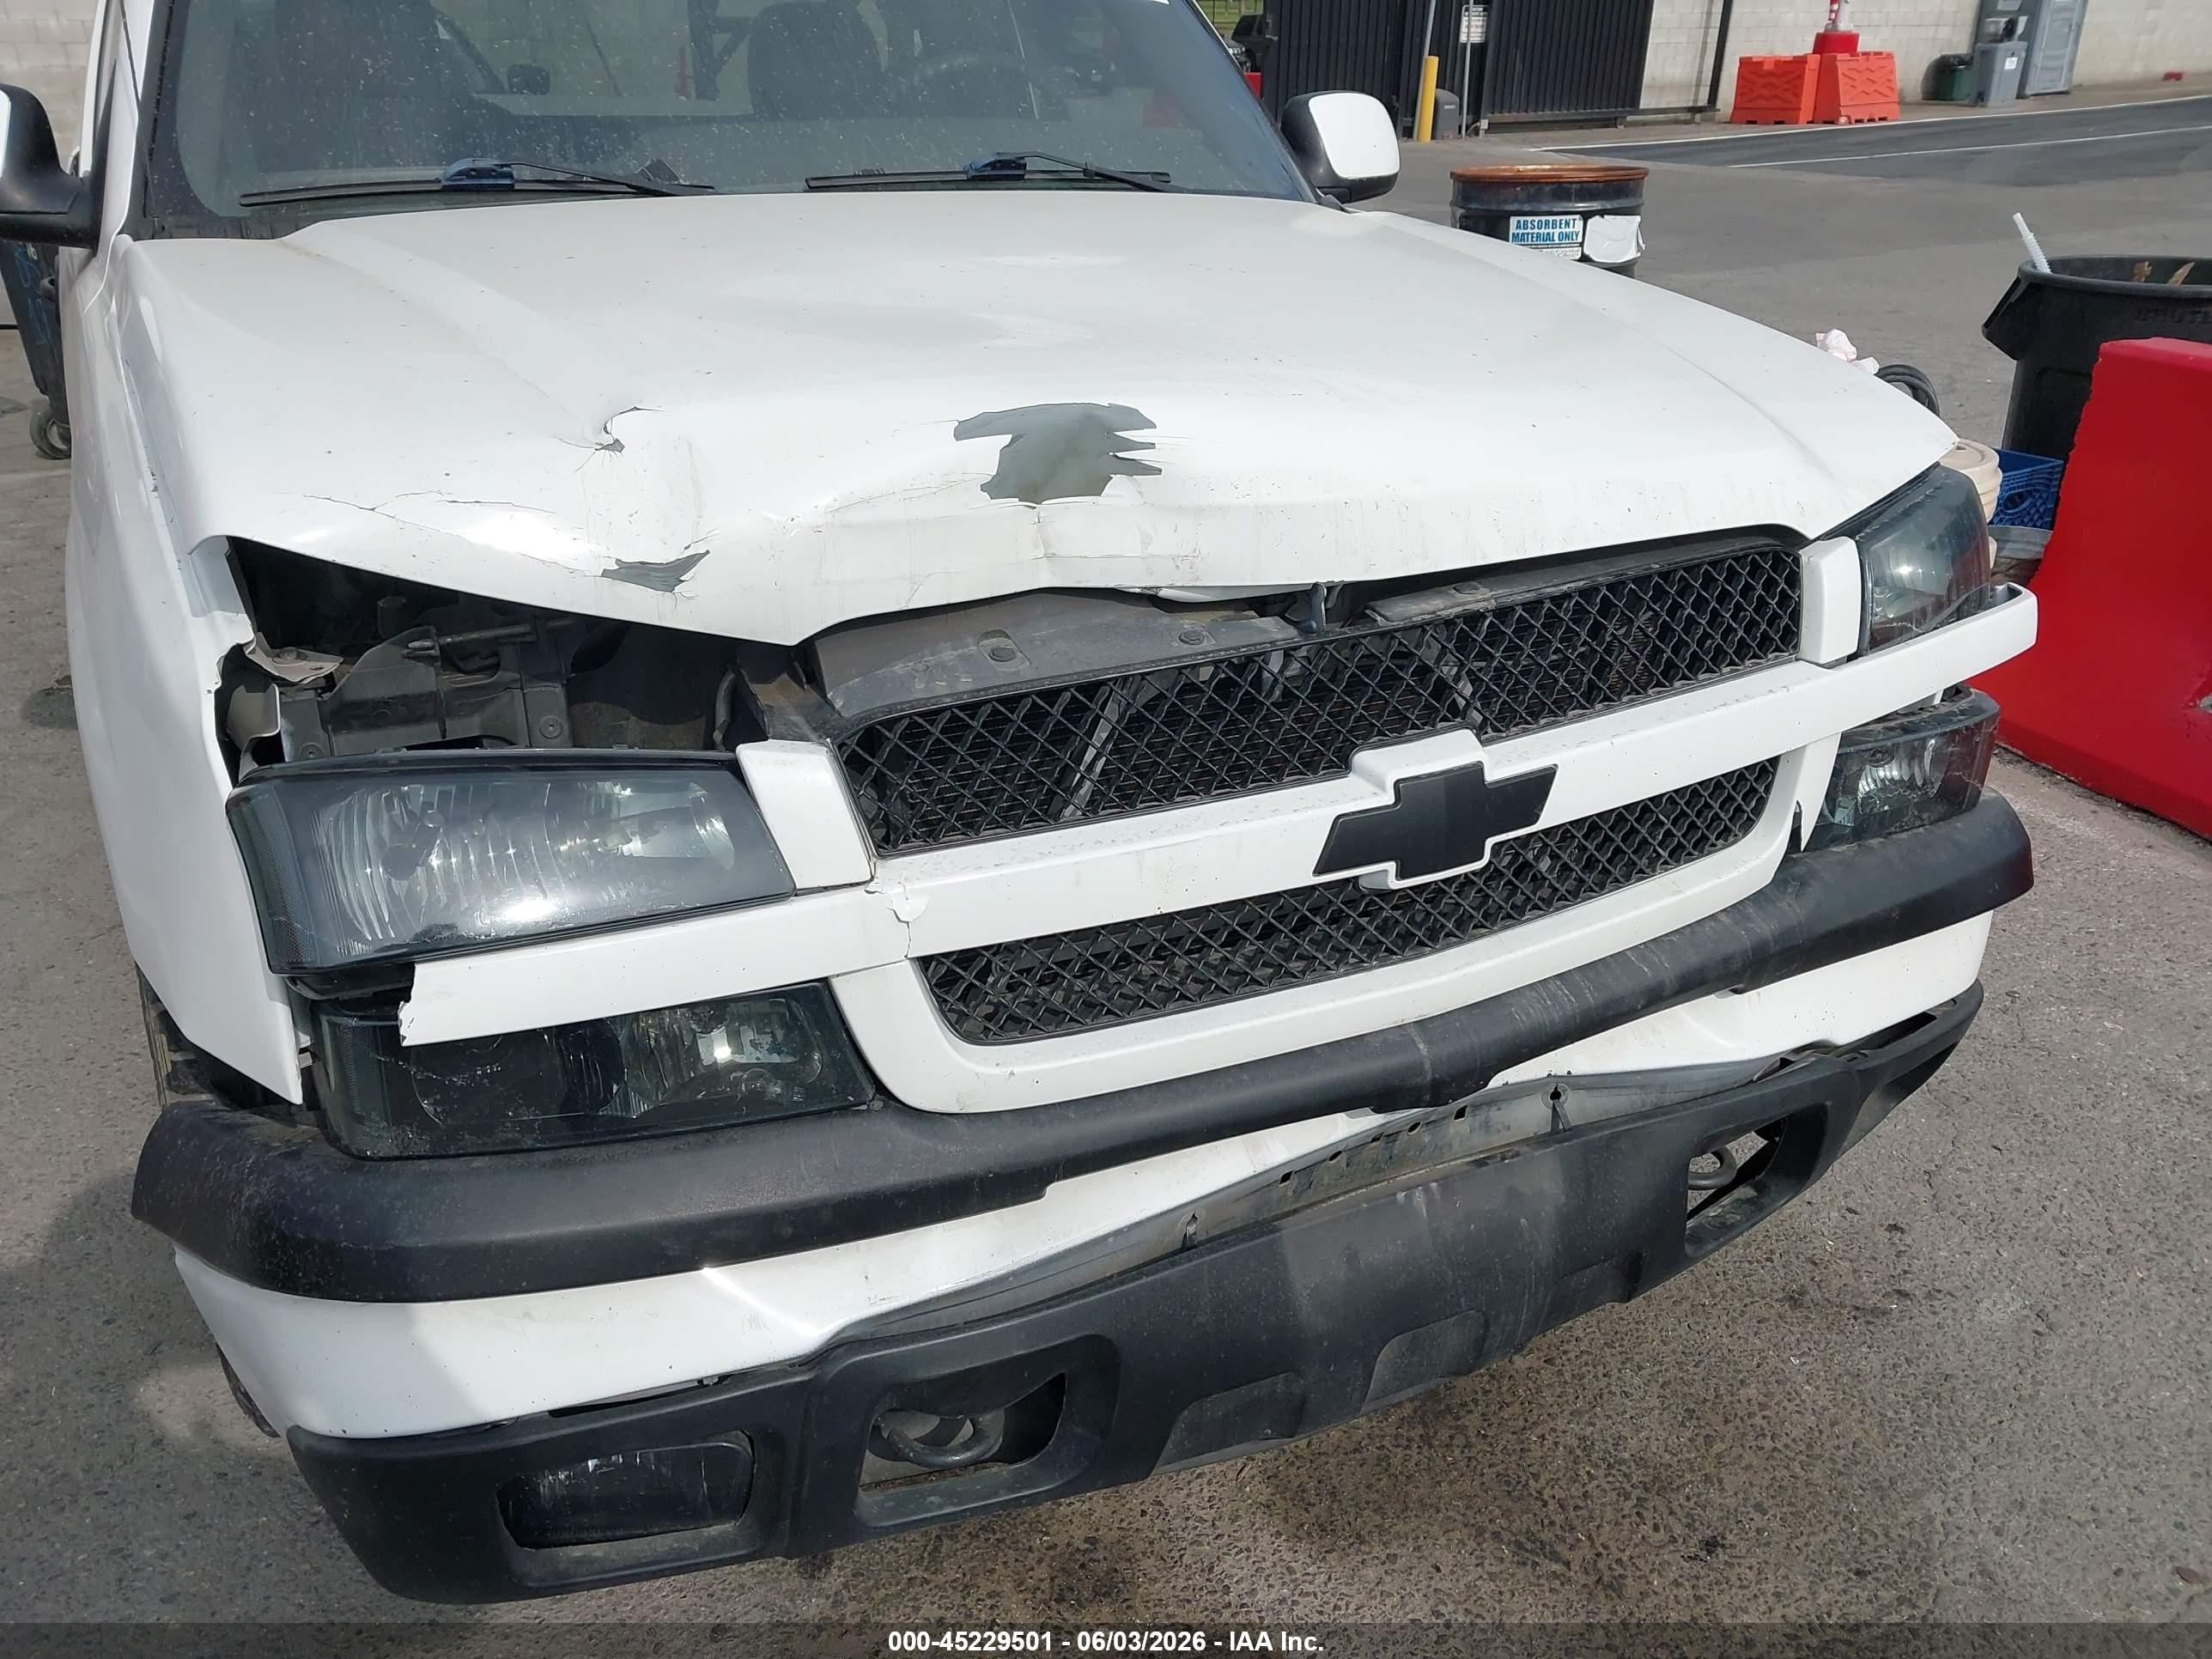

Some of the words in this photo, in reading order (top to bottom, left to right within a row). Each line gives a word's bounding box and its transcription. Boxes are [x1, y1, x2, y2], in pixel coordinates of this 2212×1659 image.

[1516, 218, 1577, 230] ABSORBENT
[1511, 231, 1556, 243] MATERIAL
[1558, 231, 1580, 242] ONLY
